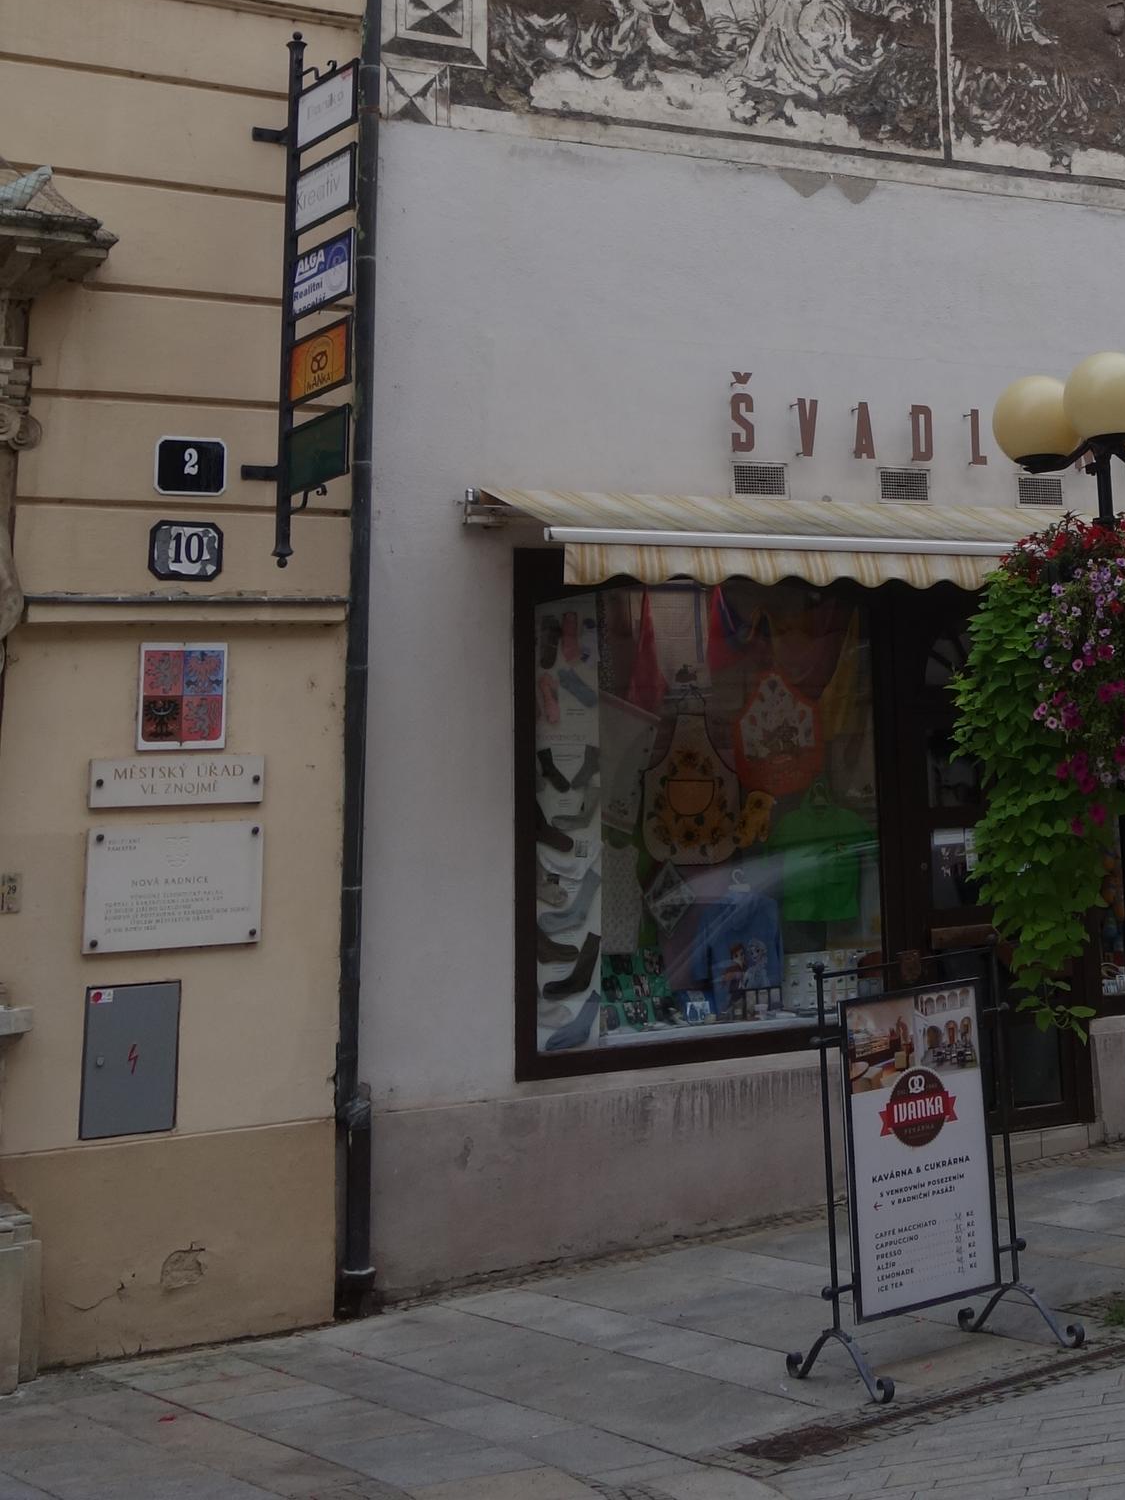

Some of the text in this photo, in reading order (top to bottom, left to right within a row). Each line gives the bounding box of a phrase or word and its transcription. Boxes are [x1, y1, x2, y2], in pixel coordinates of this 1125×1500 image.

[296, 248, 325, 275] ALGA
[183, 447, 199, 475] 2
[113, 762, 244, 781] MĚSTSKÝ ÚŘAD
[141, 783, 157, 795] VE
[131, 876, 159, 888] NOVÁ
[893, 1095, 944, 1124] IVANKA
[871, 1154, 971, 1184] KAVÁRNA & CUKRÁRNA
[886, 1181, 925, 1196] VENKOVNÍM
[927, 1172, 965, 1187] POSEZENÍM
[897, 1192, 931, 1205] RADNIČNÍ
[931, 1185, 956, 1196] PASÁŽI
[897, 1219, 937, 1235] MACCHIATO
[875, 1234, 919, 1250] CAPPUCCINO
[876, 1249, 902, 1261] PRESSO
[876, 1261, 896, 1271] ALŽÍR
[877, 1267, 915, 1282] LEMONADE
[877, 1284, 889, 1293] ICE
[891, 1281, 904, 1290] TEA
